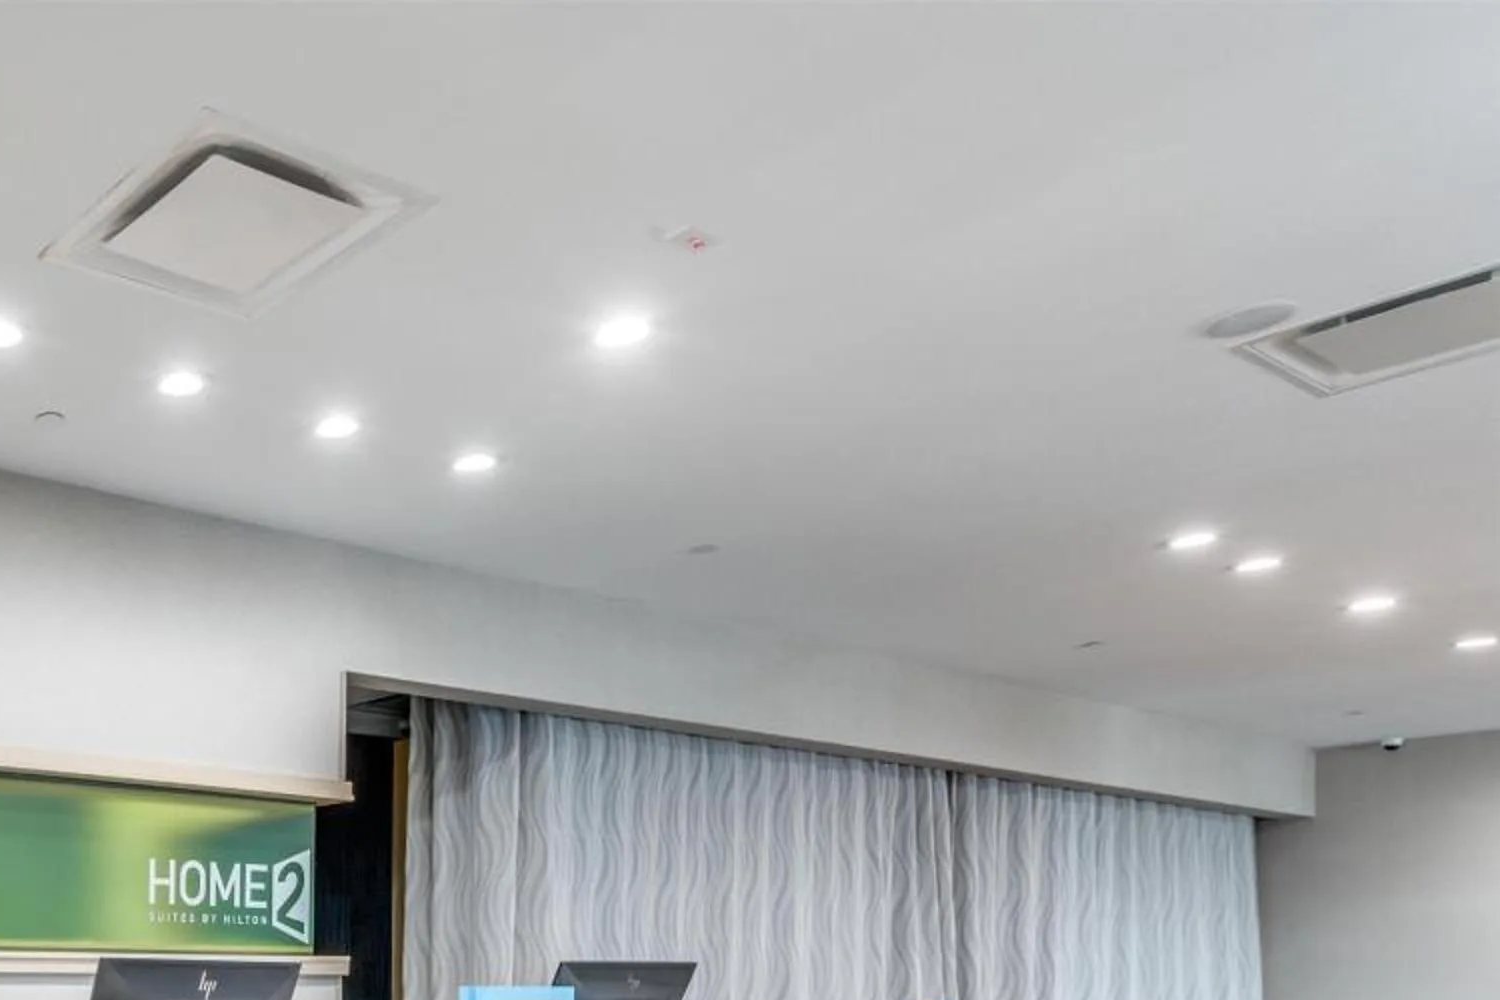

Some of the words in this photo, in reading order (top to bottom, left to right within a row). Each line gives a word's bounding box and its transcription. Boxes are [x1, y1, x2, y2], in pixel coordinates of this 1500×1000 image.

[148, 911, 195, 924] SUITES
[202, 912, 218, 925] BY
[223, 913, 268, 926] HILTON
[198, 968, 219, 1000] hp
